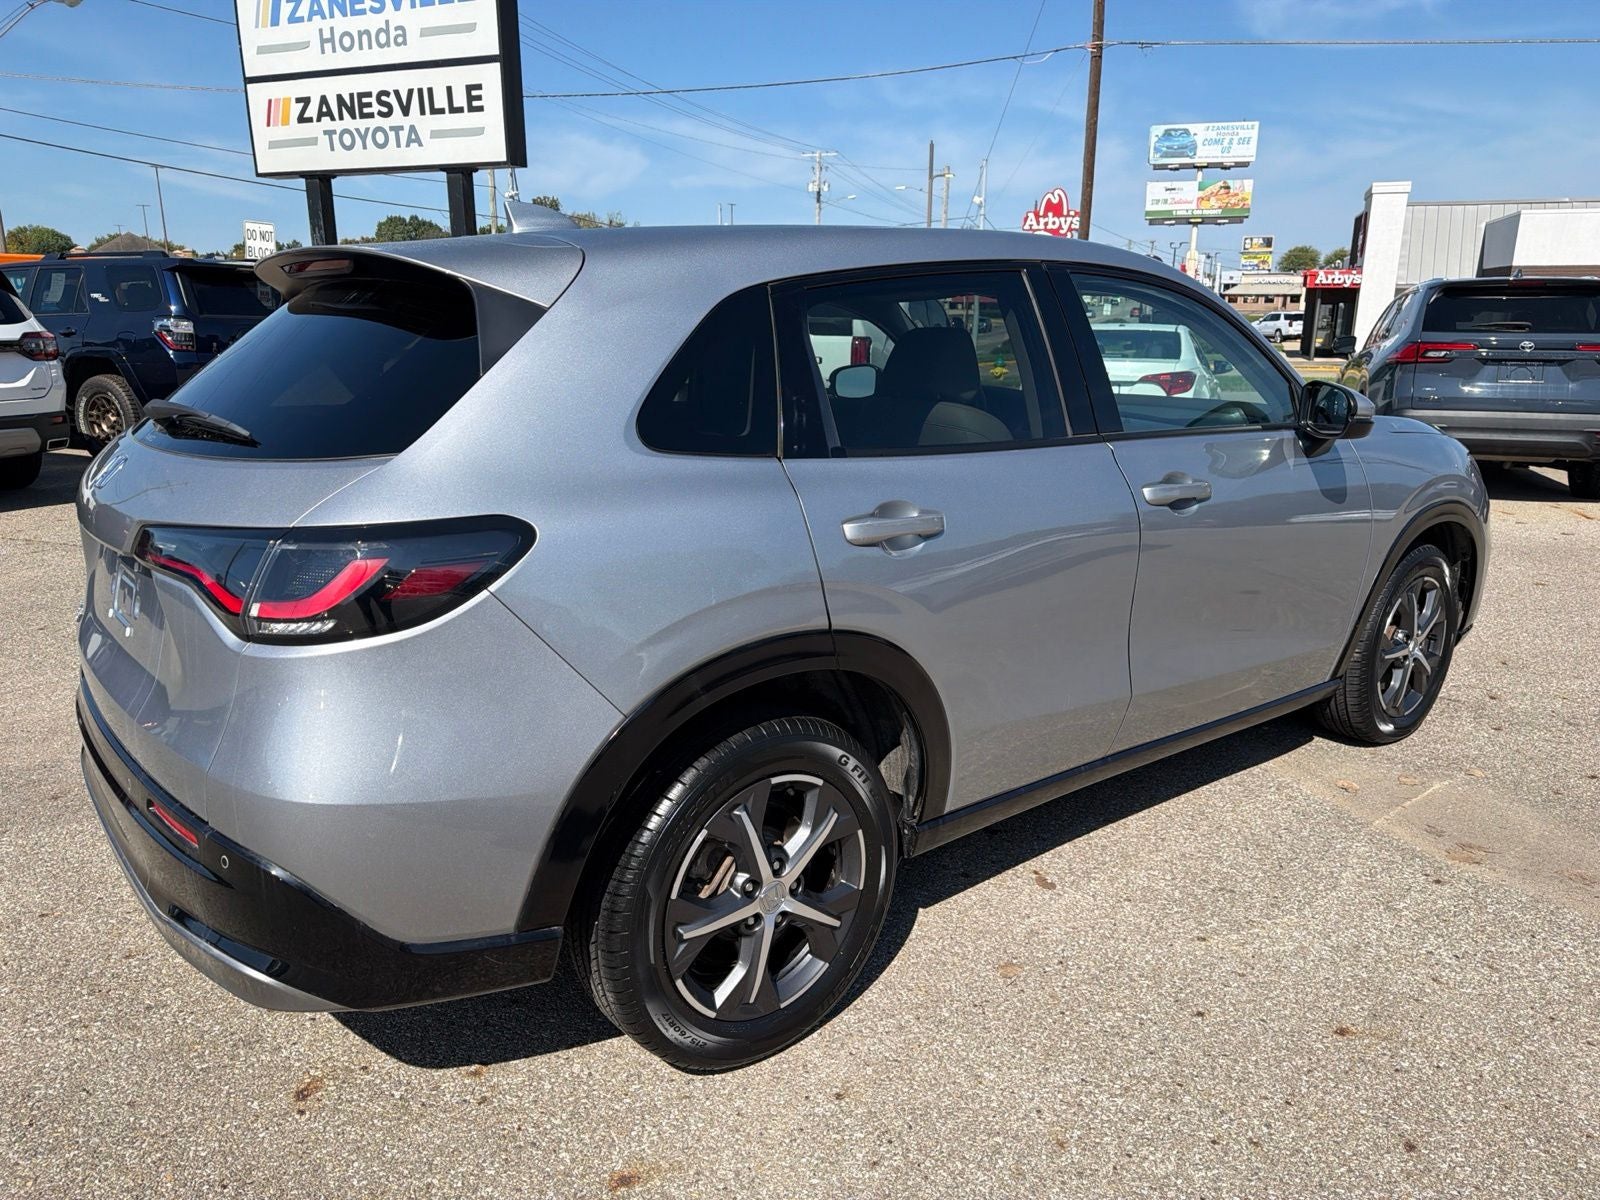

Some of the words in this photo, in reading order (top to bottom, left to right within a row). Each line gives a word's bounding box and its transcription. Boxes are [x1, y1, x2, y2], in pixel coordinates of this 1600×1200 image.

[318, 20, 408, 54] Honda
[295, 83, 484, 124] ZANESVILLE
[323, 124, 424, 152] TOYOTA
[1211, 124, 1256, 132] ZANESVILLE
[1202, 138, 1226, 146] COME
[1236, 137, 1252, 145] SEE
[1220, 146, 1232, 154] US
[1023, 211, 1080, 234] Arby's
[246, 228, 257, 241] DO
[259, 230, 274, 243] NOT
[1314, 270, 1362, 287] Arby's
[837, 754, 850, 767] G
[850, 764, 871, 784] FIT
[661, 1012, 708, 1049] 215/60R17
